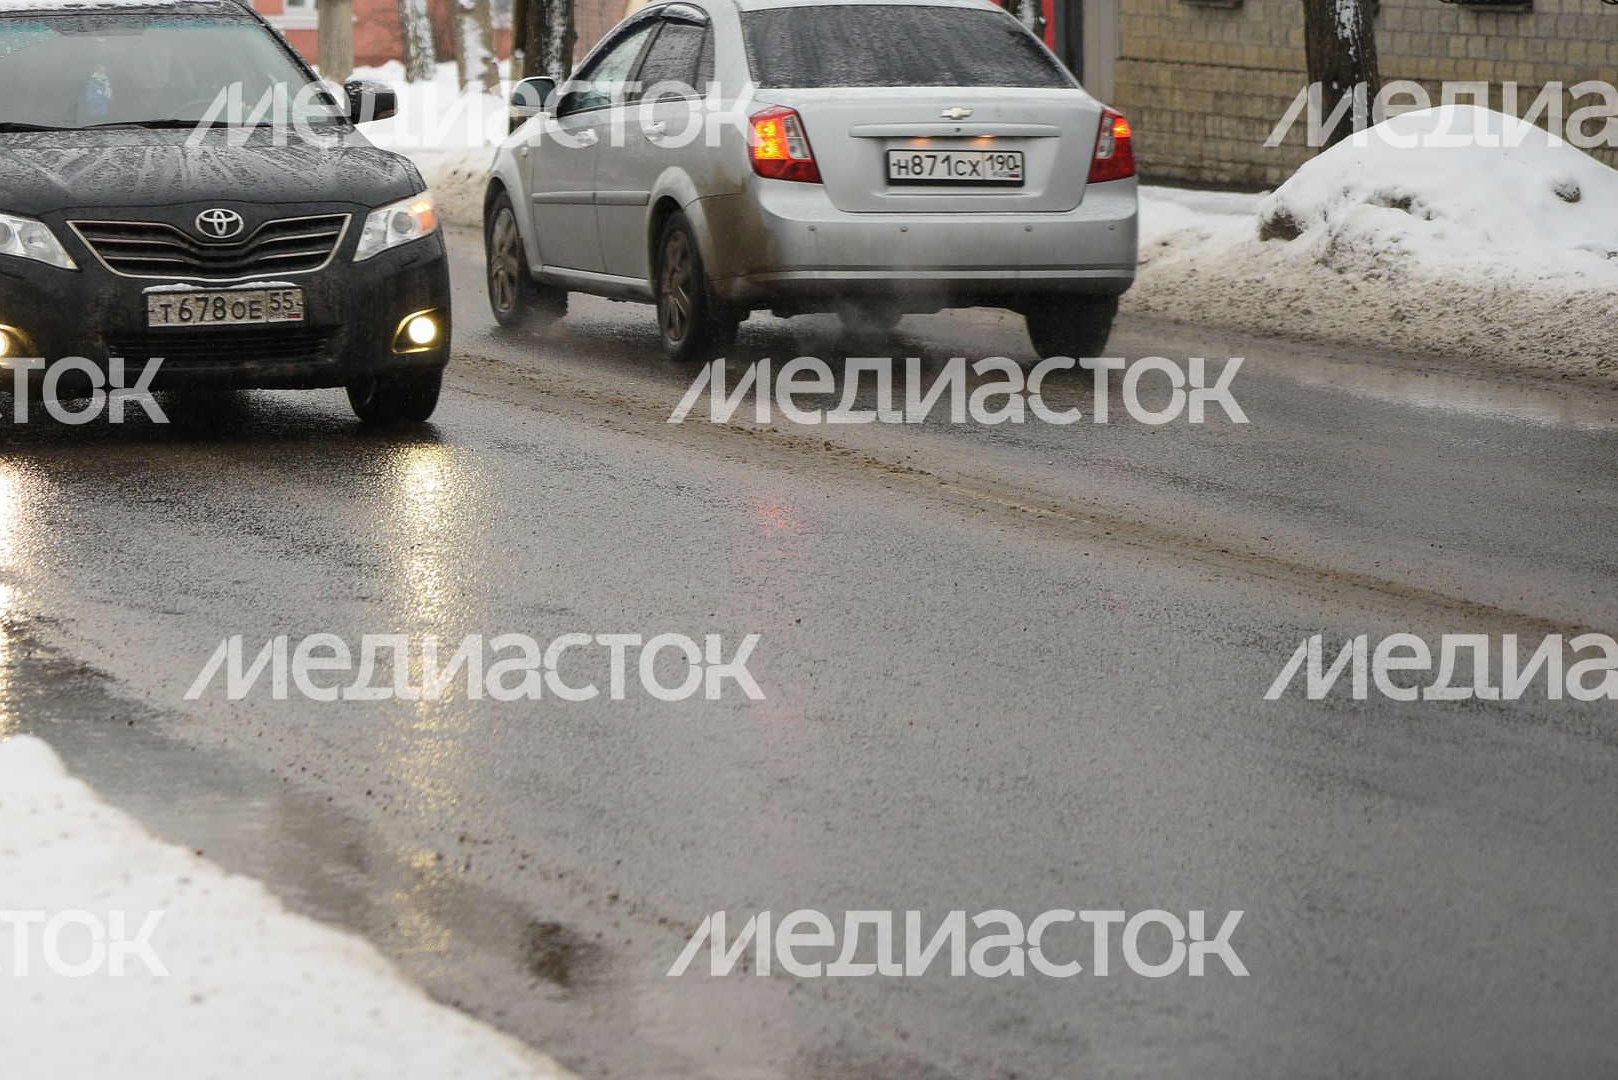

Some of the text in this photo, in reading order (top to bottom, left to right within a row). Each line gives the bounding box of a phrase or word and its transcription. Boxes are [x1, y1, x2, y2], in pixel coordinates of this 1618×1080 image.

[896, 155, 1016, 176] Н871СХ 190
[159, 292, 294, 323] Т678ОЕ 55
